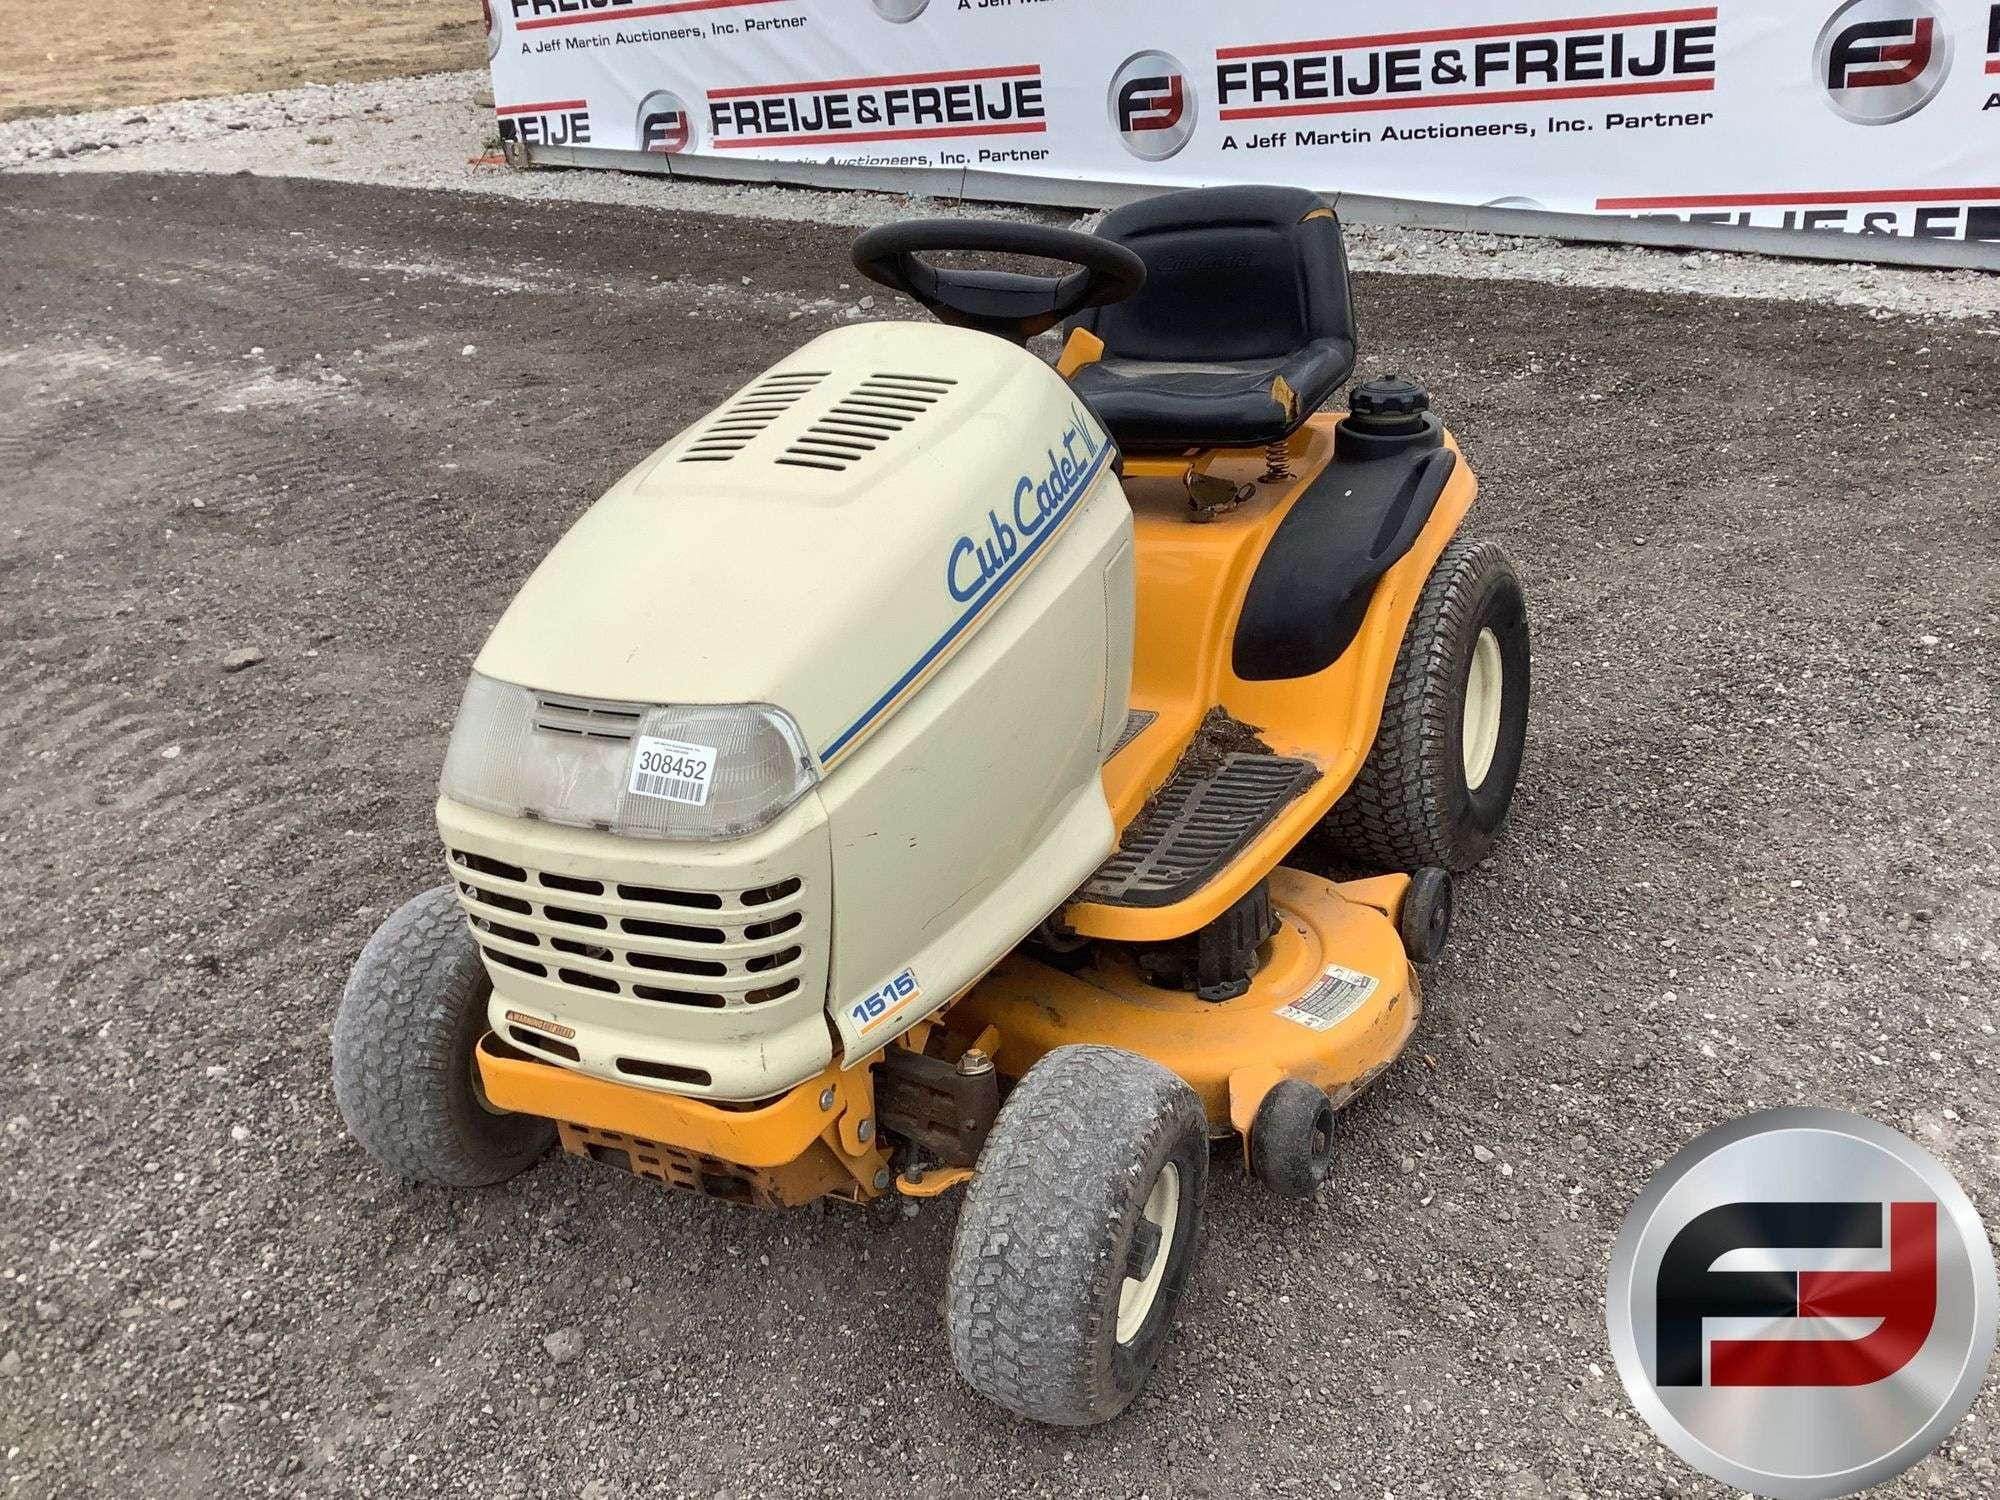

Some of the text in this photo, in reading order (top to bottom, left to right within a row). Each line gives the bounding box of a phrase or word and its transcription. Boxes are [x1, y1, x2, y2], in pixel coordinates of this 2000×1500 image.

[521, 16, 808, 54] A Jeff Martin Auctioneers, Inc. Partner
[1221, 112, 1714, 151] A Jeff Martin Auctioneers, Inc. Partner
[940, 151, 971, 165] Inc.
[978, 149, 1050, 163] Partner
[947, 429, 1088, 602] Cub Cadet
[639, 751, 707, 780] 308452
[852, 972, 915, 1023] 1515
